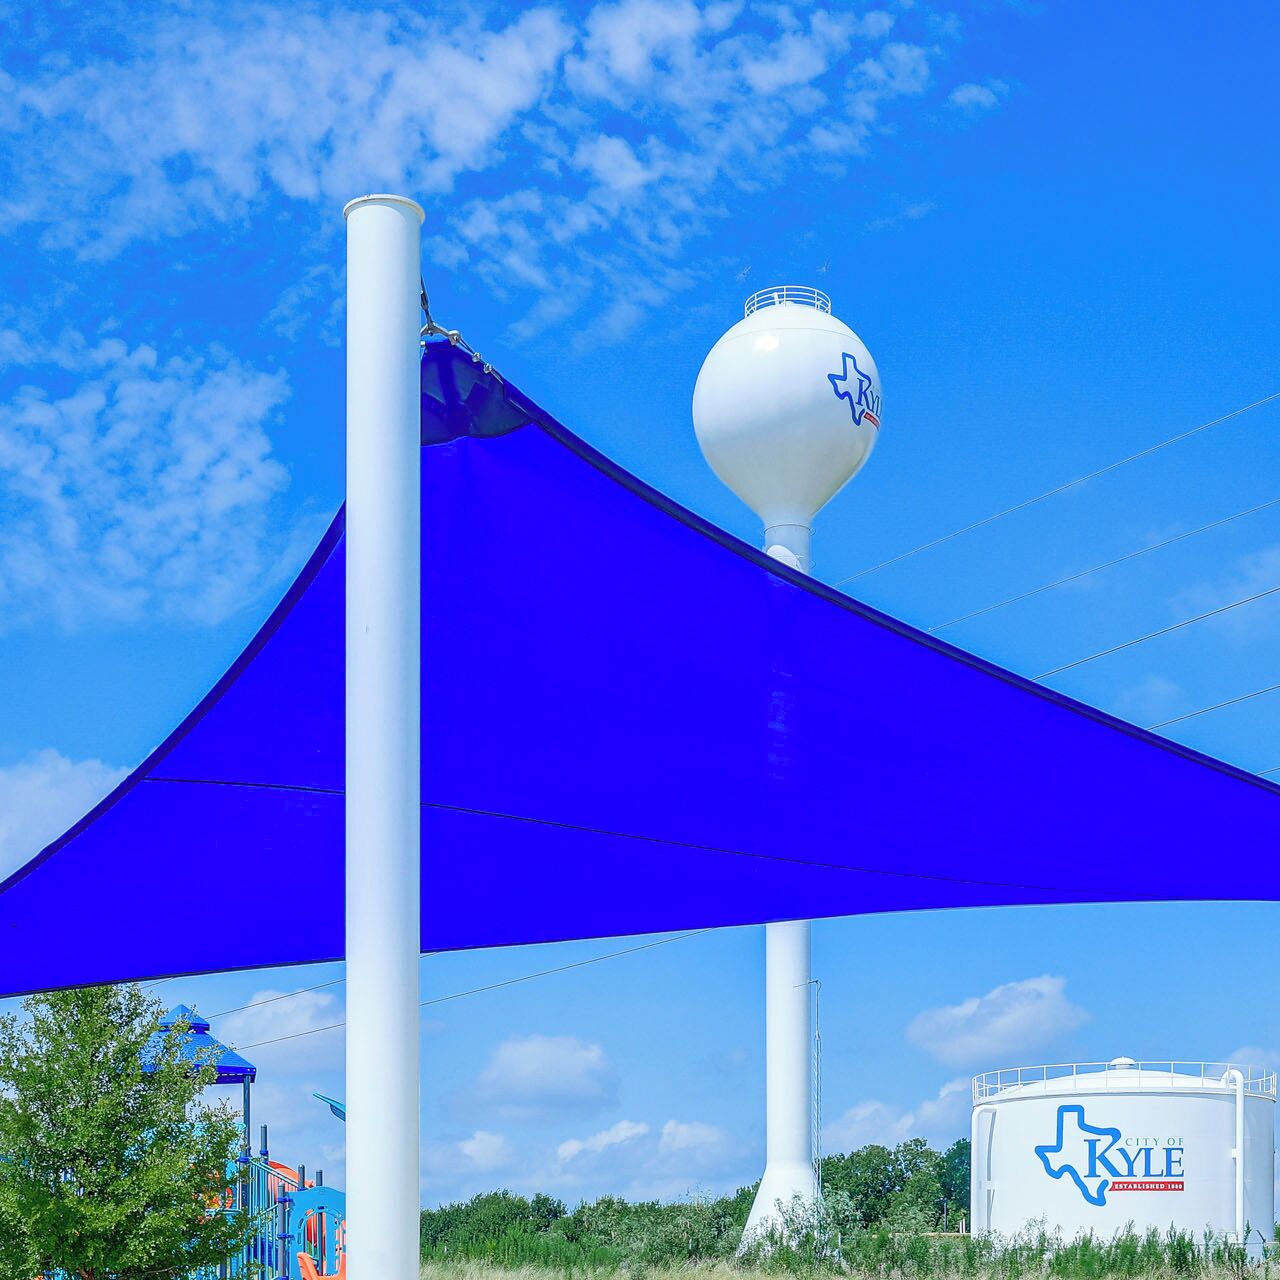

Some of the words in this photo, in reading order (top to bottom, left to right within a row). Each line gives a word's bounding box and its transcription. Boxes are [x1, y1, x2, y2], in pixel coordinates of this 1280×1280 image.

[855, 377, 882, 420] KYL
[1084, 1139, 1184, 1178] KYLE
[1125, 1137, 1160, 1146] CITY
[1167, 1137, 1184, 1146] OF
